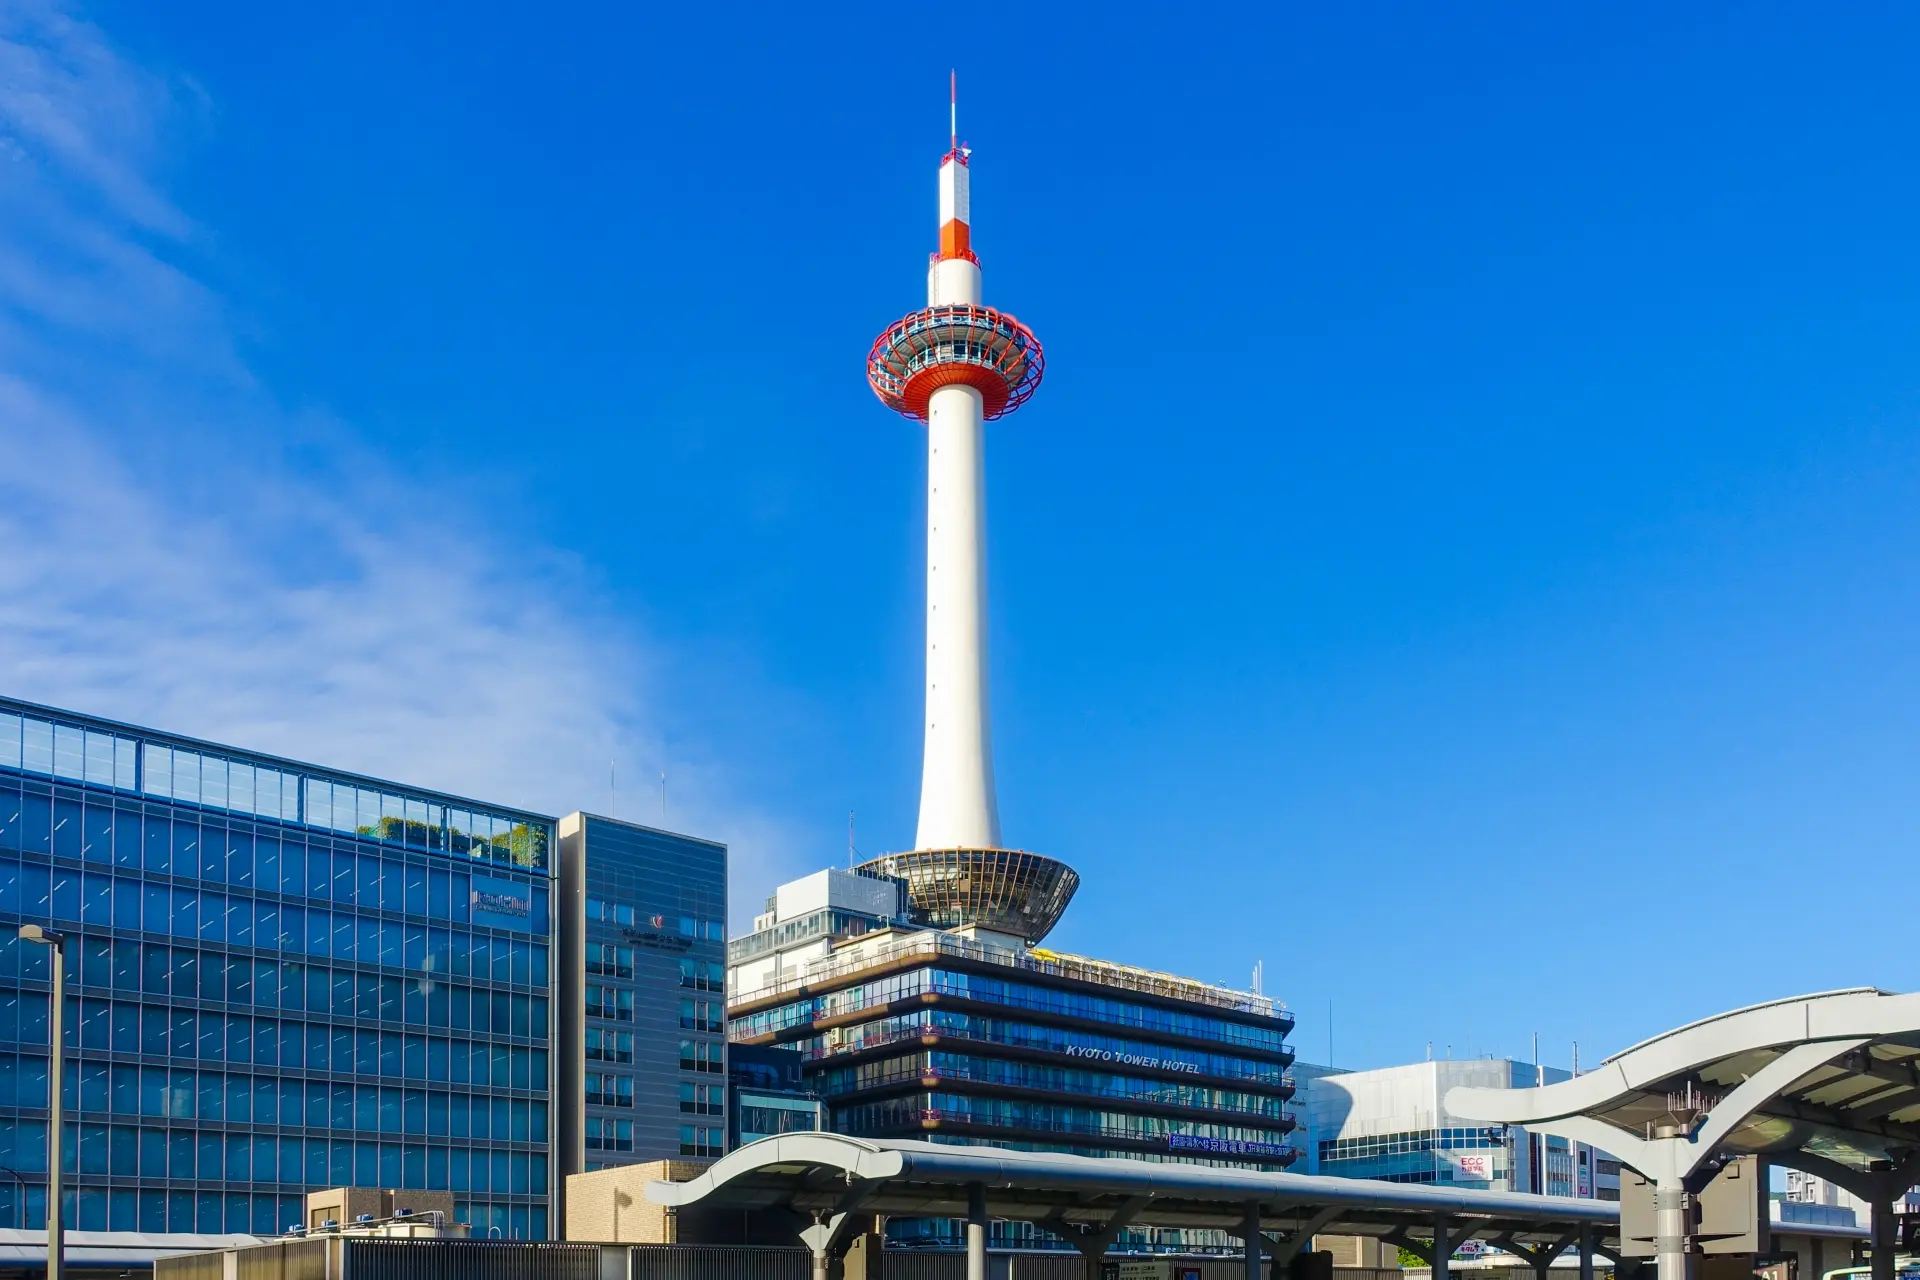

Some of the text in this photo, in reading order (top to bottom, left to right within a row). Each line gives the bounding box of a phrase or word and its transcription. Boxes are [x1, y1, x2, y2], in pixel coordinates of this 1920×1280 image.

[1065, 1045, 1200, 1074] KYOTO TOWER HOTEL
[1461, 1157, 1484, 1165] ECC
[1762, 1270, 1778, 1280] A1
